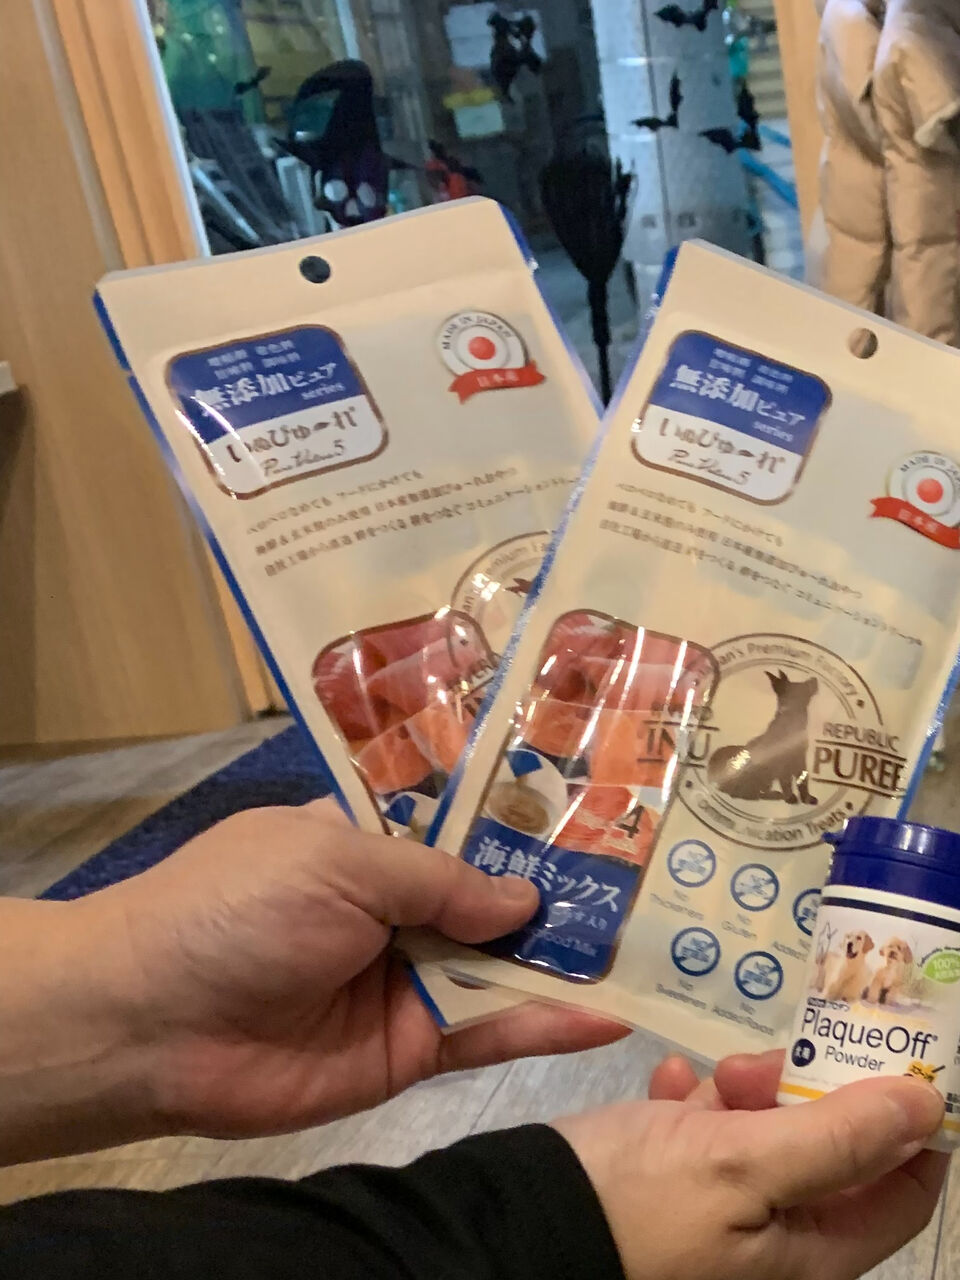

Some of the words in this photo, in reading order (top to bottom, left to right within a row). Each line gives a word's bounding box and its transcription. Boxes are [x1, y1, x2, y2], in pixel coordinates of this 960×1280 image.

[821, 721, 902, 754] REPUBLIC
[472, 834, 623, 914] 海鮮ミックス
[800, 1007, 935, 1060] PlaqueOff
[824, 1045, 886, 1073] Powder
